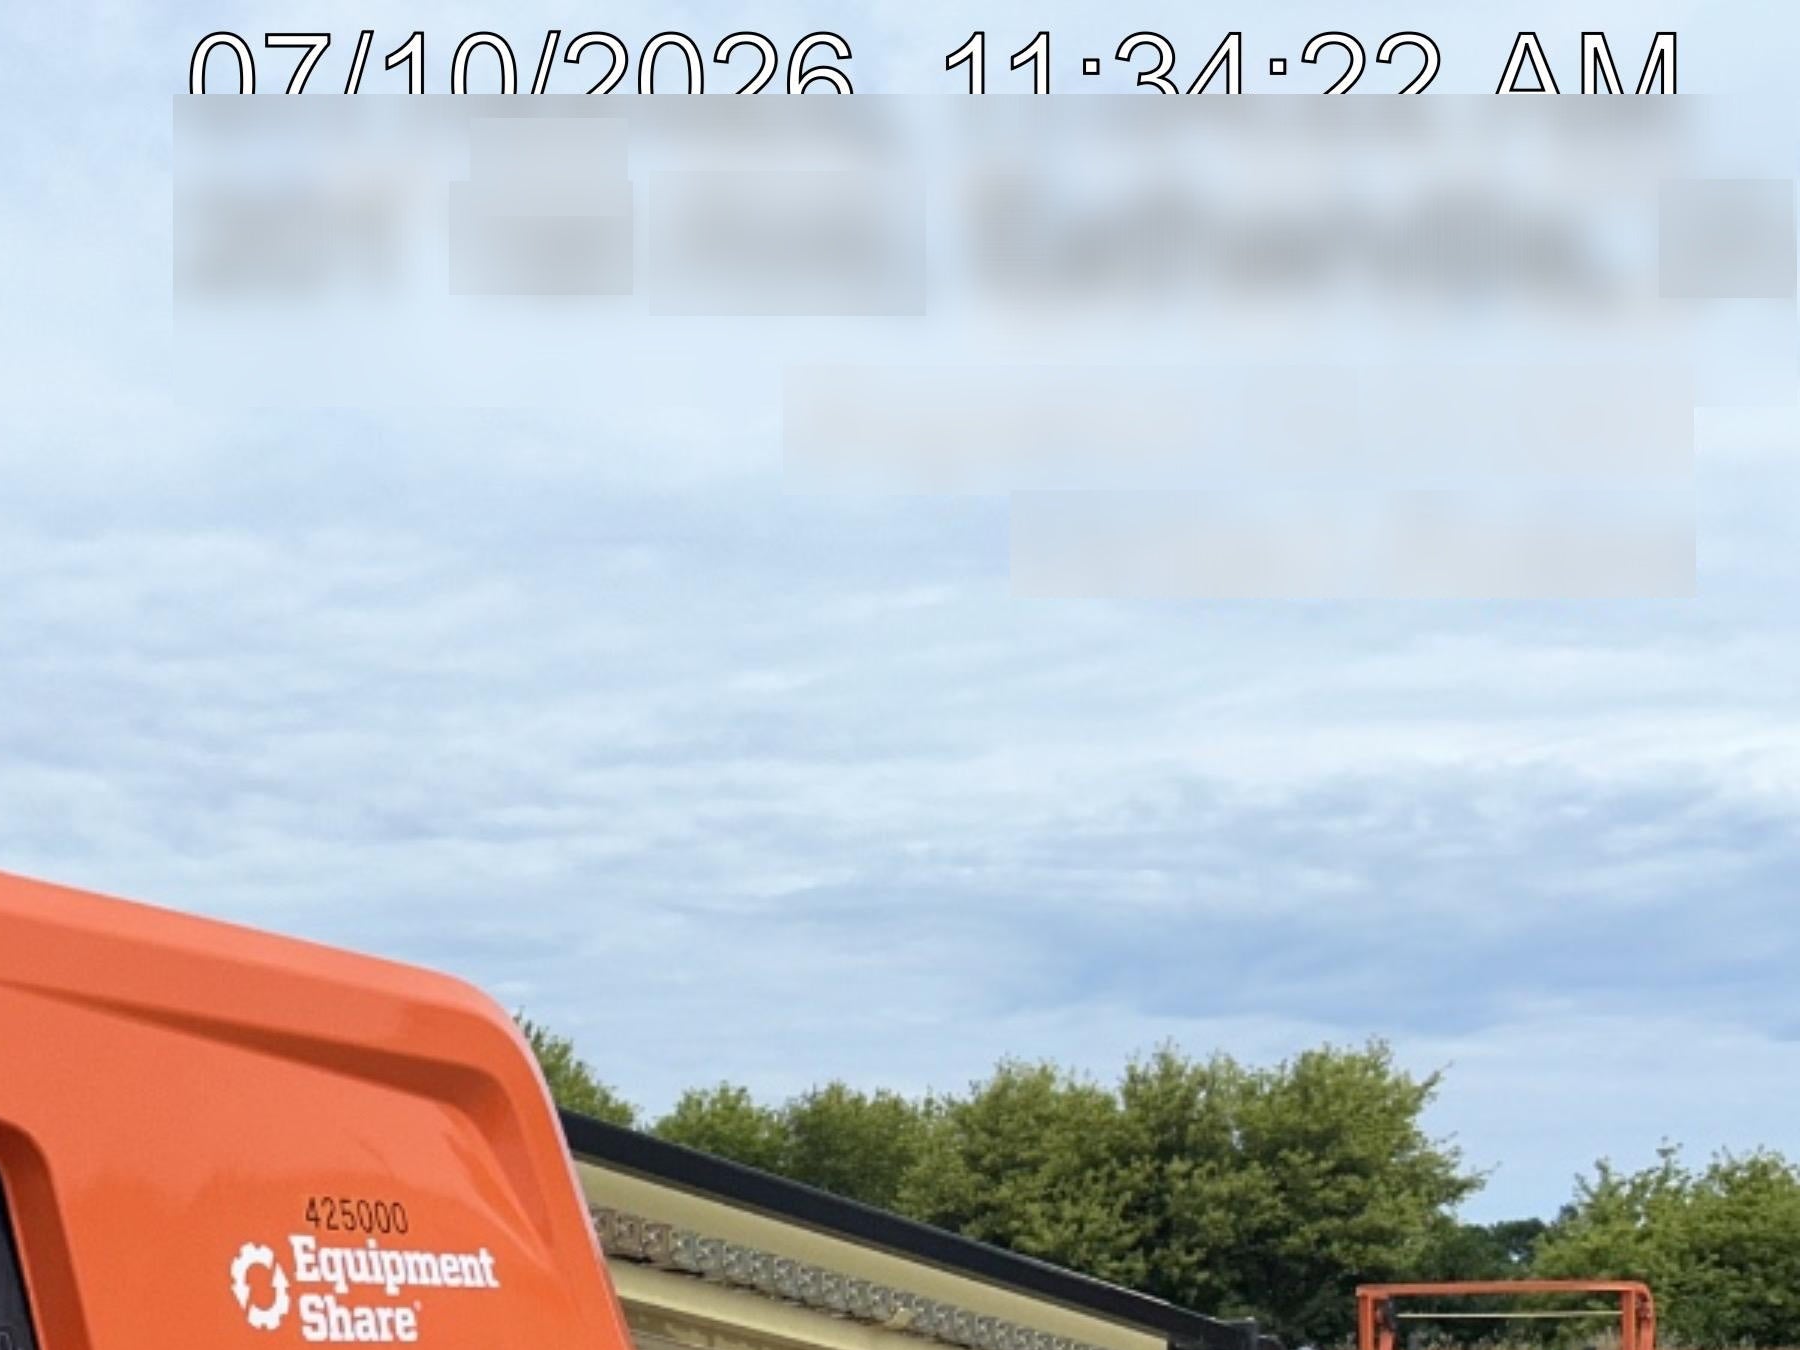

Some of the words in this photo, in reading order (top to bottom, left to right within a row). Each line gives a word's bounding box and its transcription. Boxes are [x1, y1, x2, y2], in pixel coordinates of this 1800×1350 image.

[304, 1195, 410, 1235] 425000
[288, 1234, 501, 1296] Equipment
[298, 1293, 419, 1342] Share
